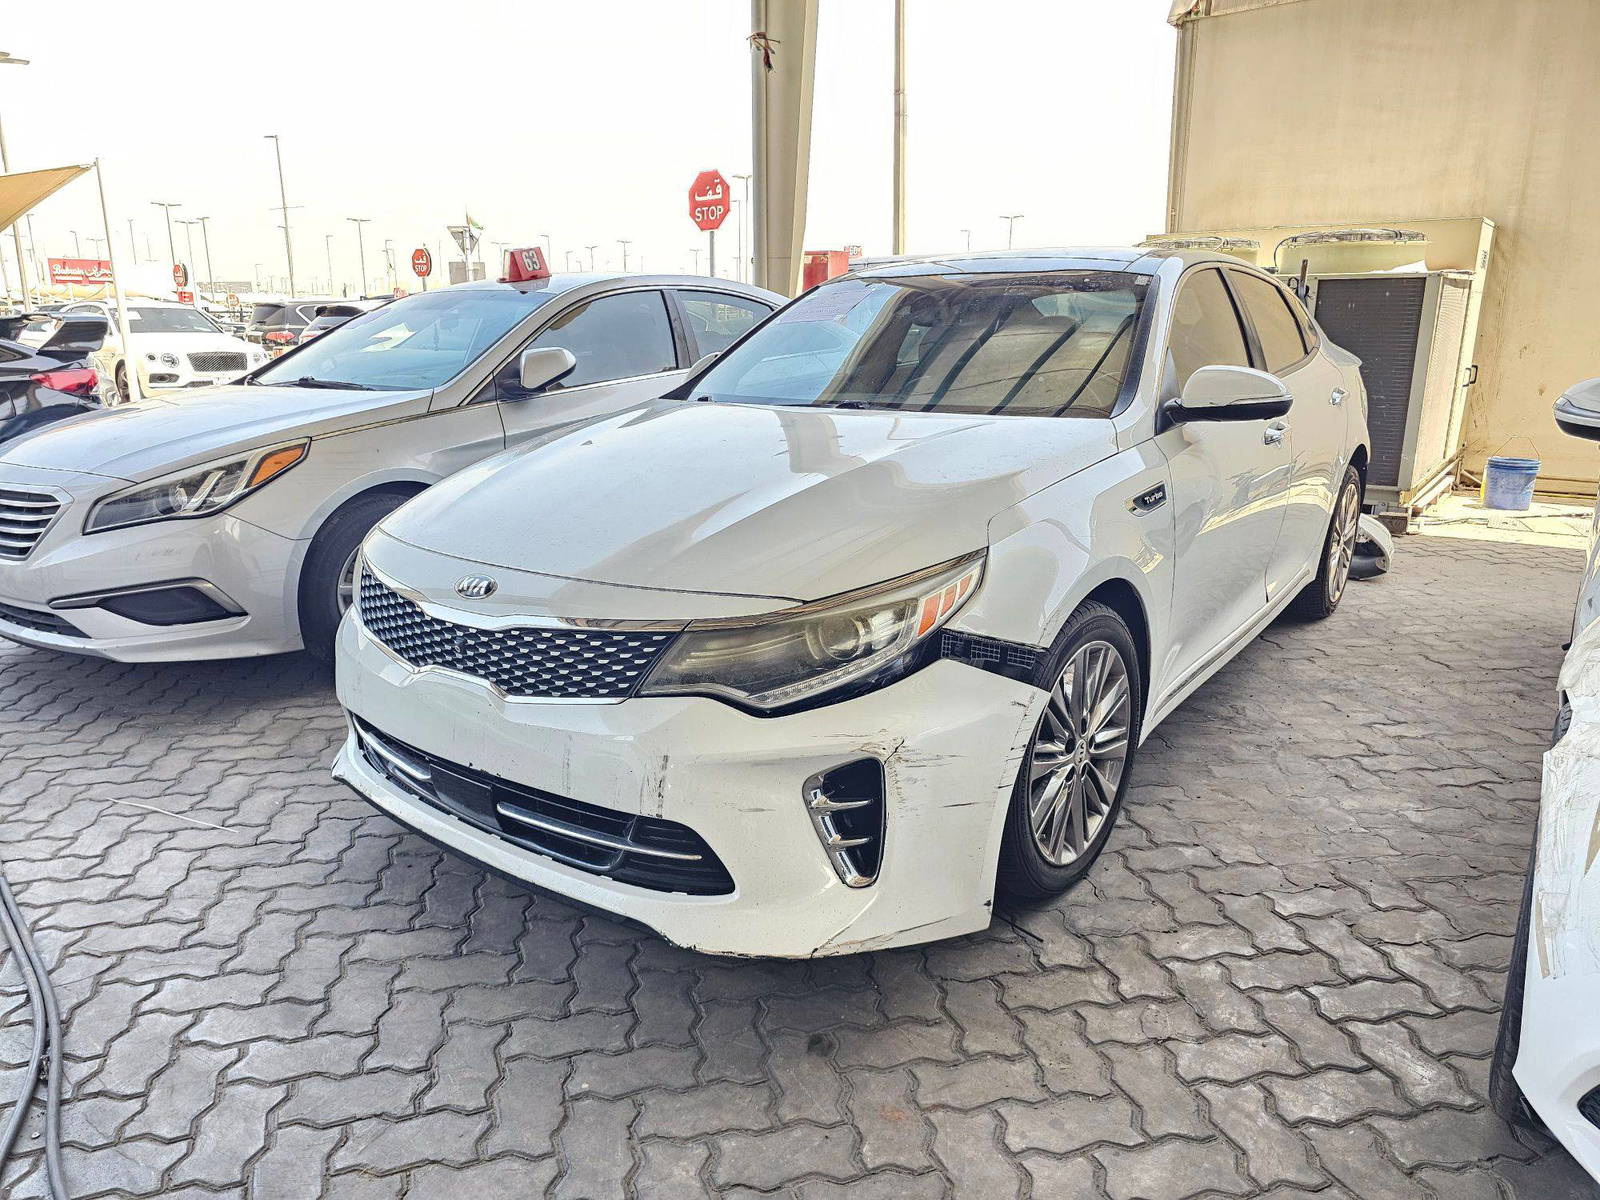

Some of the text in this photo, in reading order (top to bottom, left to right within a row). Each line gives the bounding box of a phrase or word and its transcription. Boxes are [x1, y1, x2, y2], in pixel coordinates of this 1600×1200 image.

[695, 179, 723, 201] قف
[695, 205, 724, 221] STOP
[522, 250, 541, 272] 63
[1144, 491, 1163, 504] Turbo
[458, 576, 491, 596] KIA
